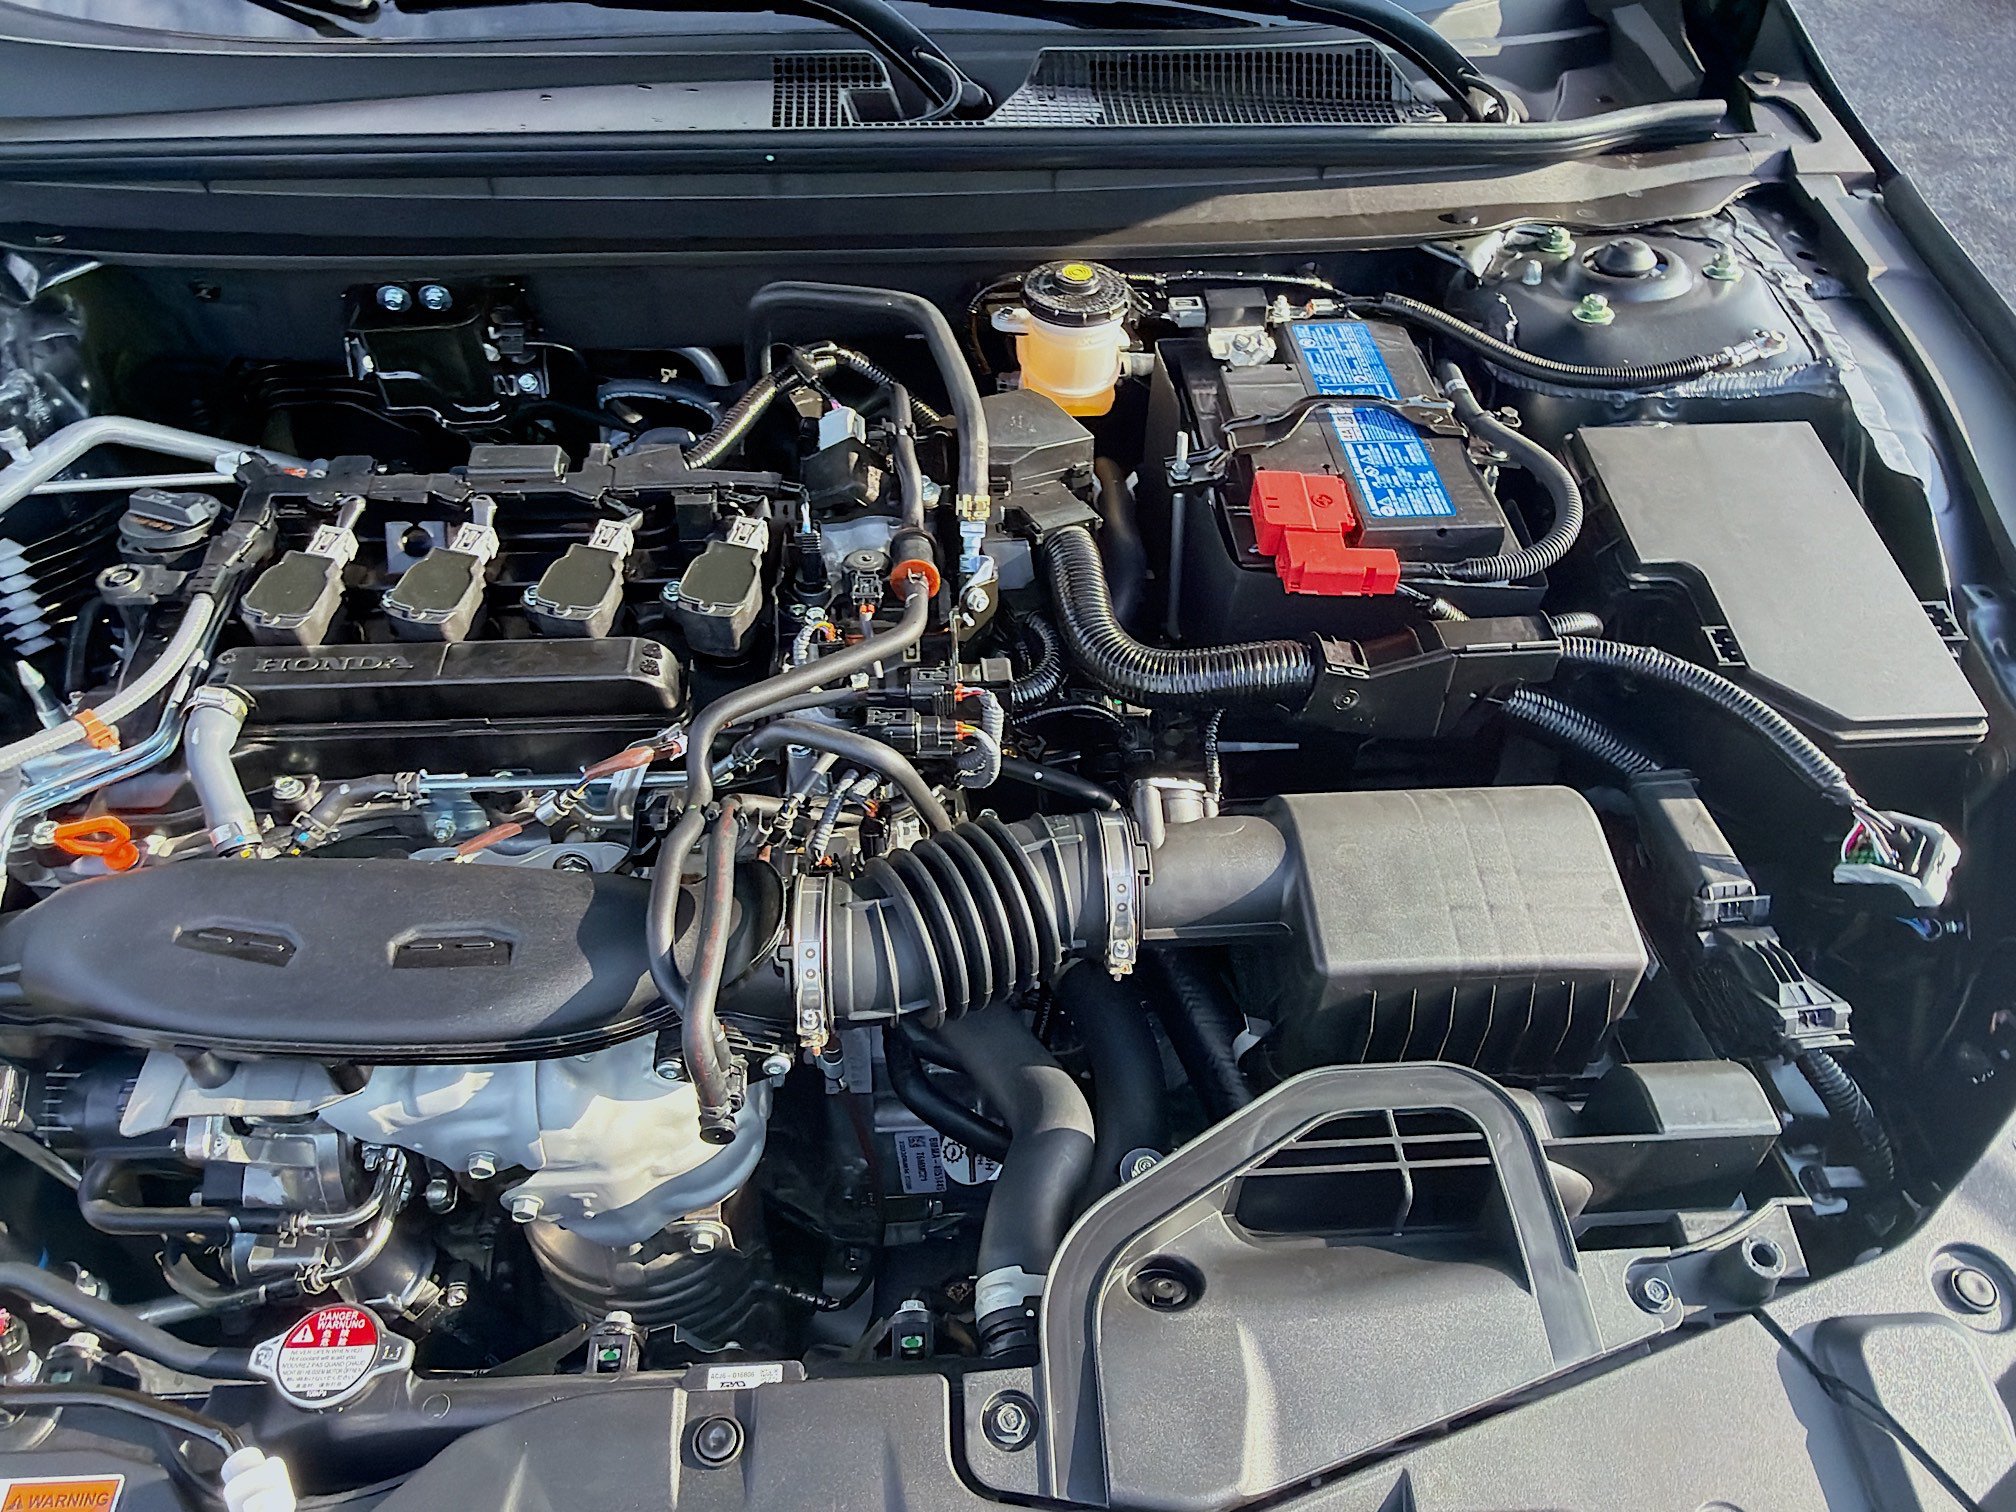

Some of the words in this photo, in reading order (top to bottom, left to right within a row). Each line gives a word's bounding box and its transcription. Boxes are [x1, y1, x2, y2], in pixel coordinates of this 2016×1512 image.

[252, 655, 413, 673] HONDA
[317, 1319, 366, 1330] WARNUNG
[318, 1311, 358, 1321] DANGER
[381, 1344, 402, 1361] 1.1
[28, 1492, 109, 1509] WARNING
